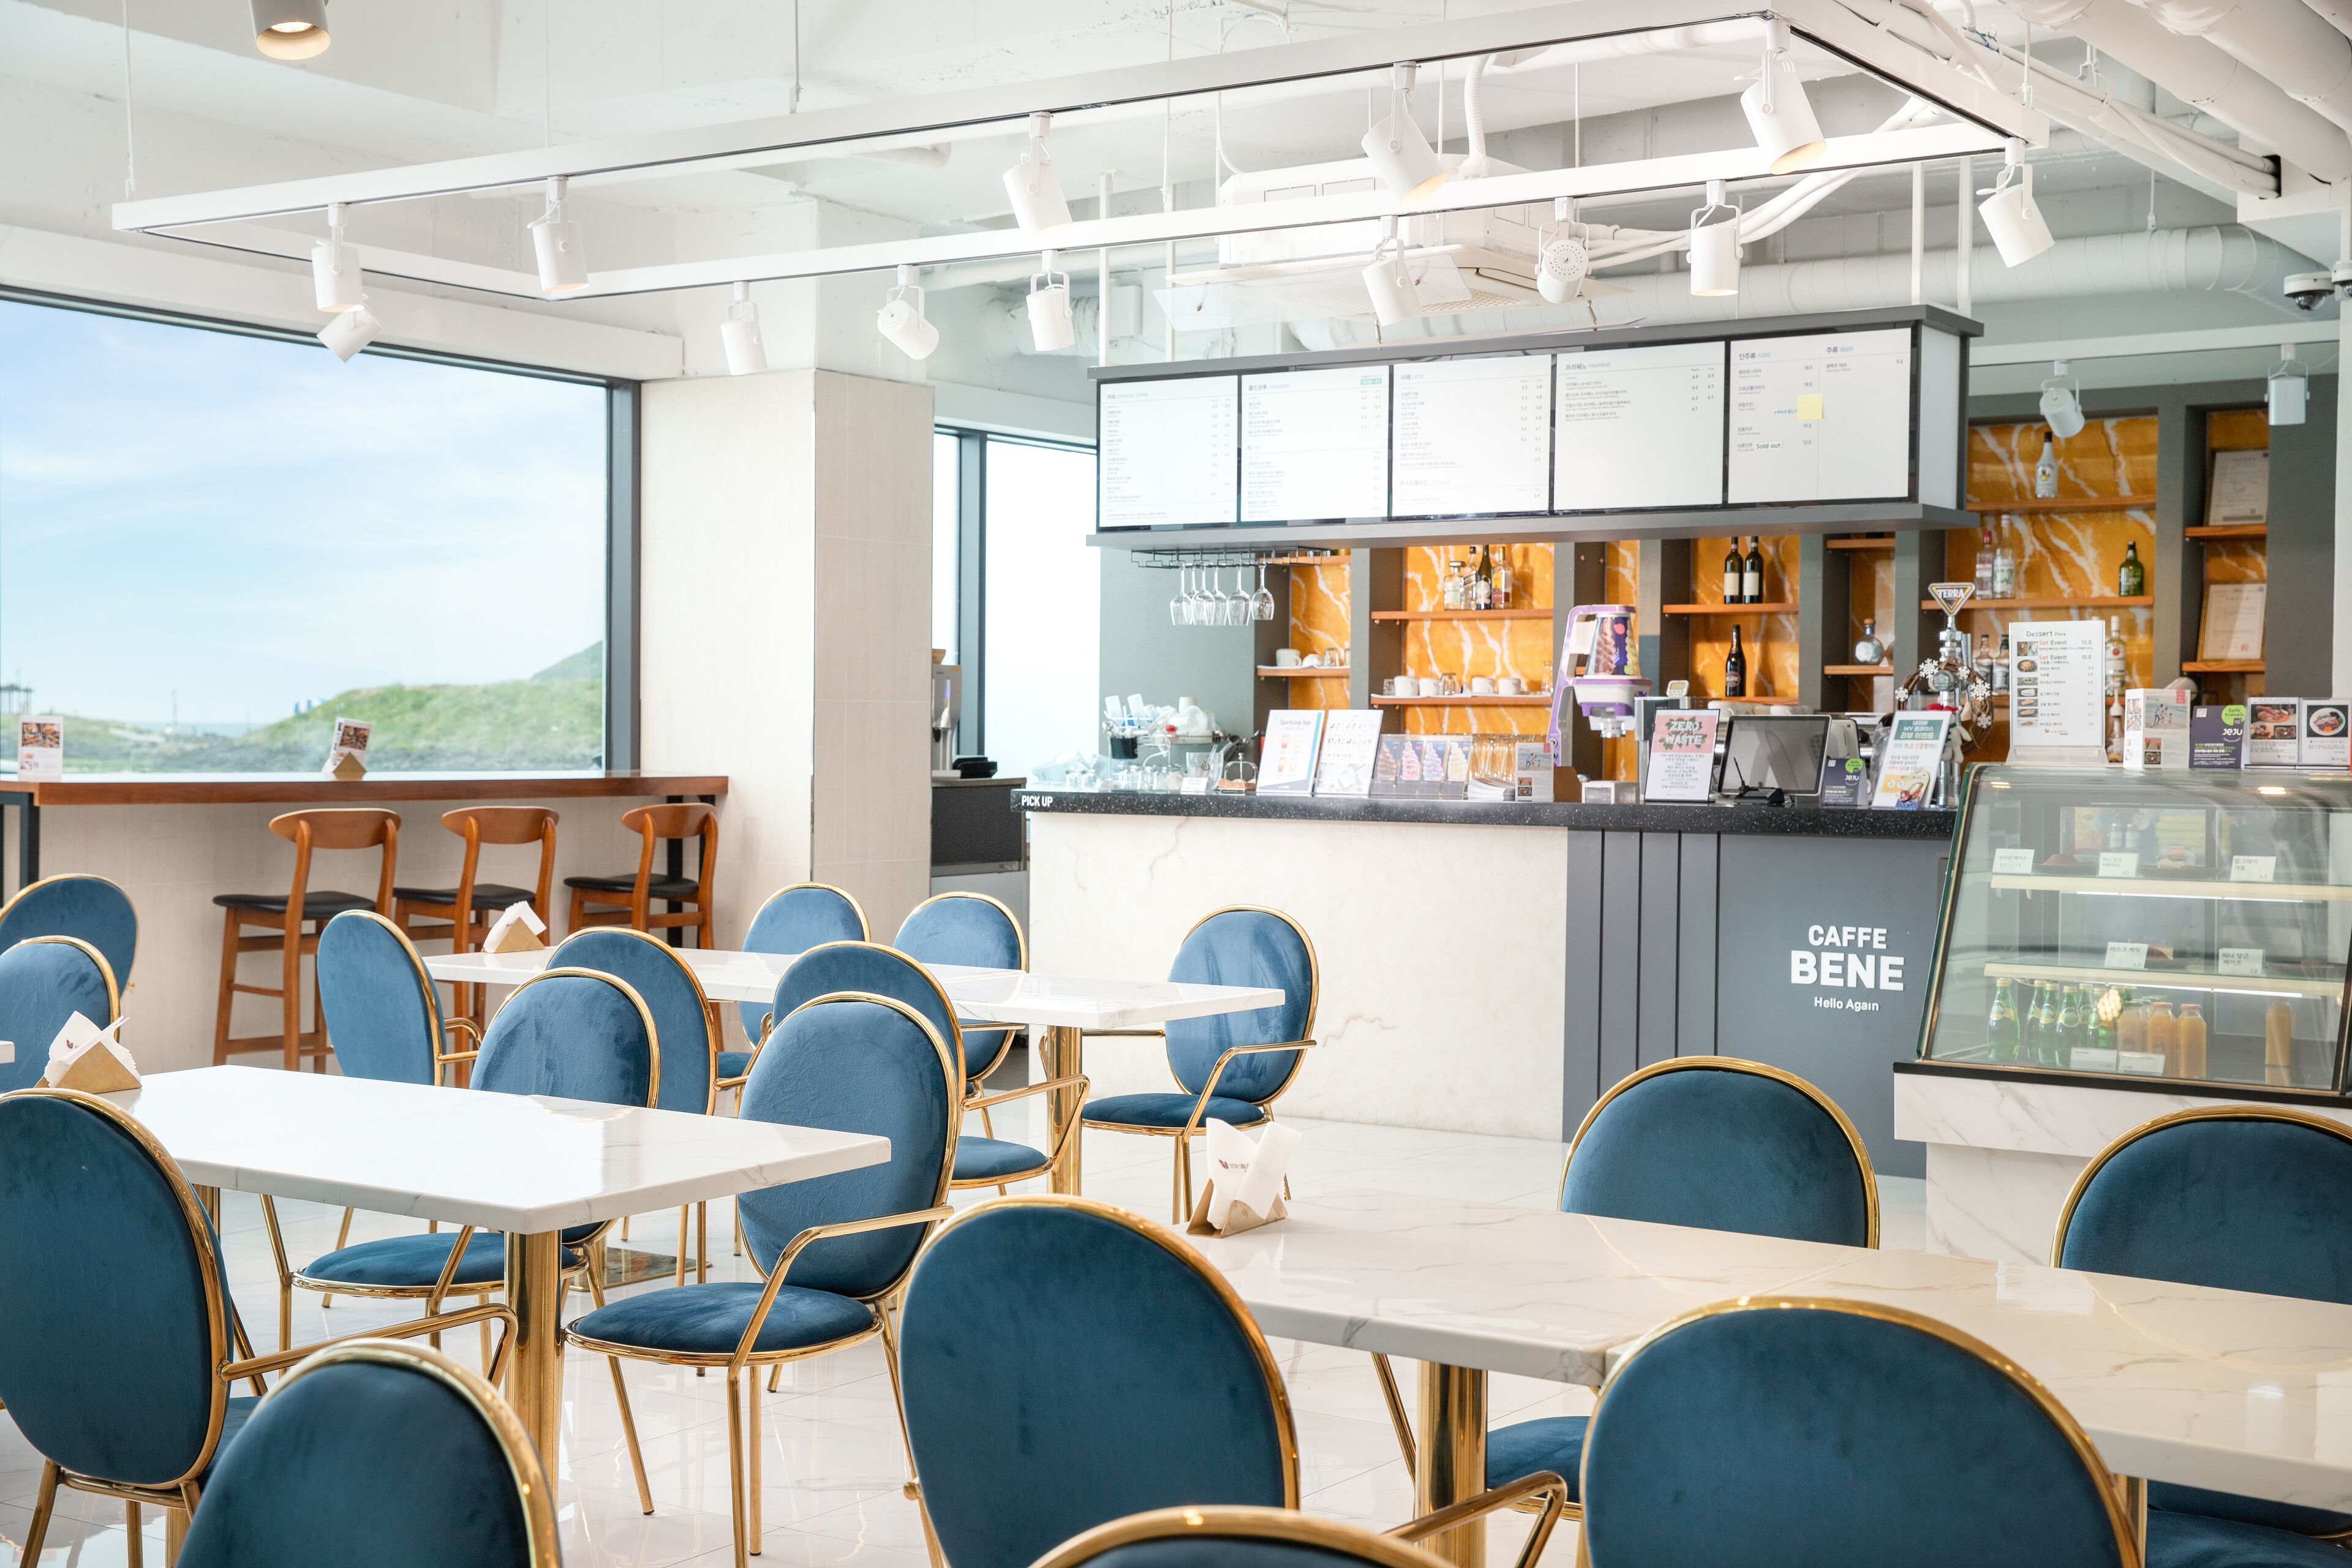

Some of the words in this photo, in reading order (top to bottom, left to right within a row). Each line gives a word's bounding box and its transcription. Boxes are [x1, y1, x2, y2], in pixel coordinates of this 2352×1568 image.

[1937, 589, 1965, 598] TERRA
[1670, 721, 1700, 731] ZERO
[1665, 734, 1703, 745] WASTE
[1022, 795, 1040, 807] PICK
[1042, 796, 1053, 807] UP
[1808, 925, 1887, 949] CAFFE
[1791, 950, 1904, 991] BENE
[1814, 997, 1843, 1009] Hello
[1845, 999, 1879, 1012] Again
